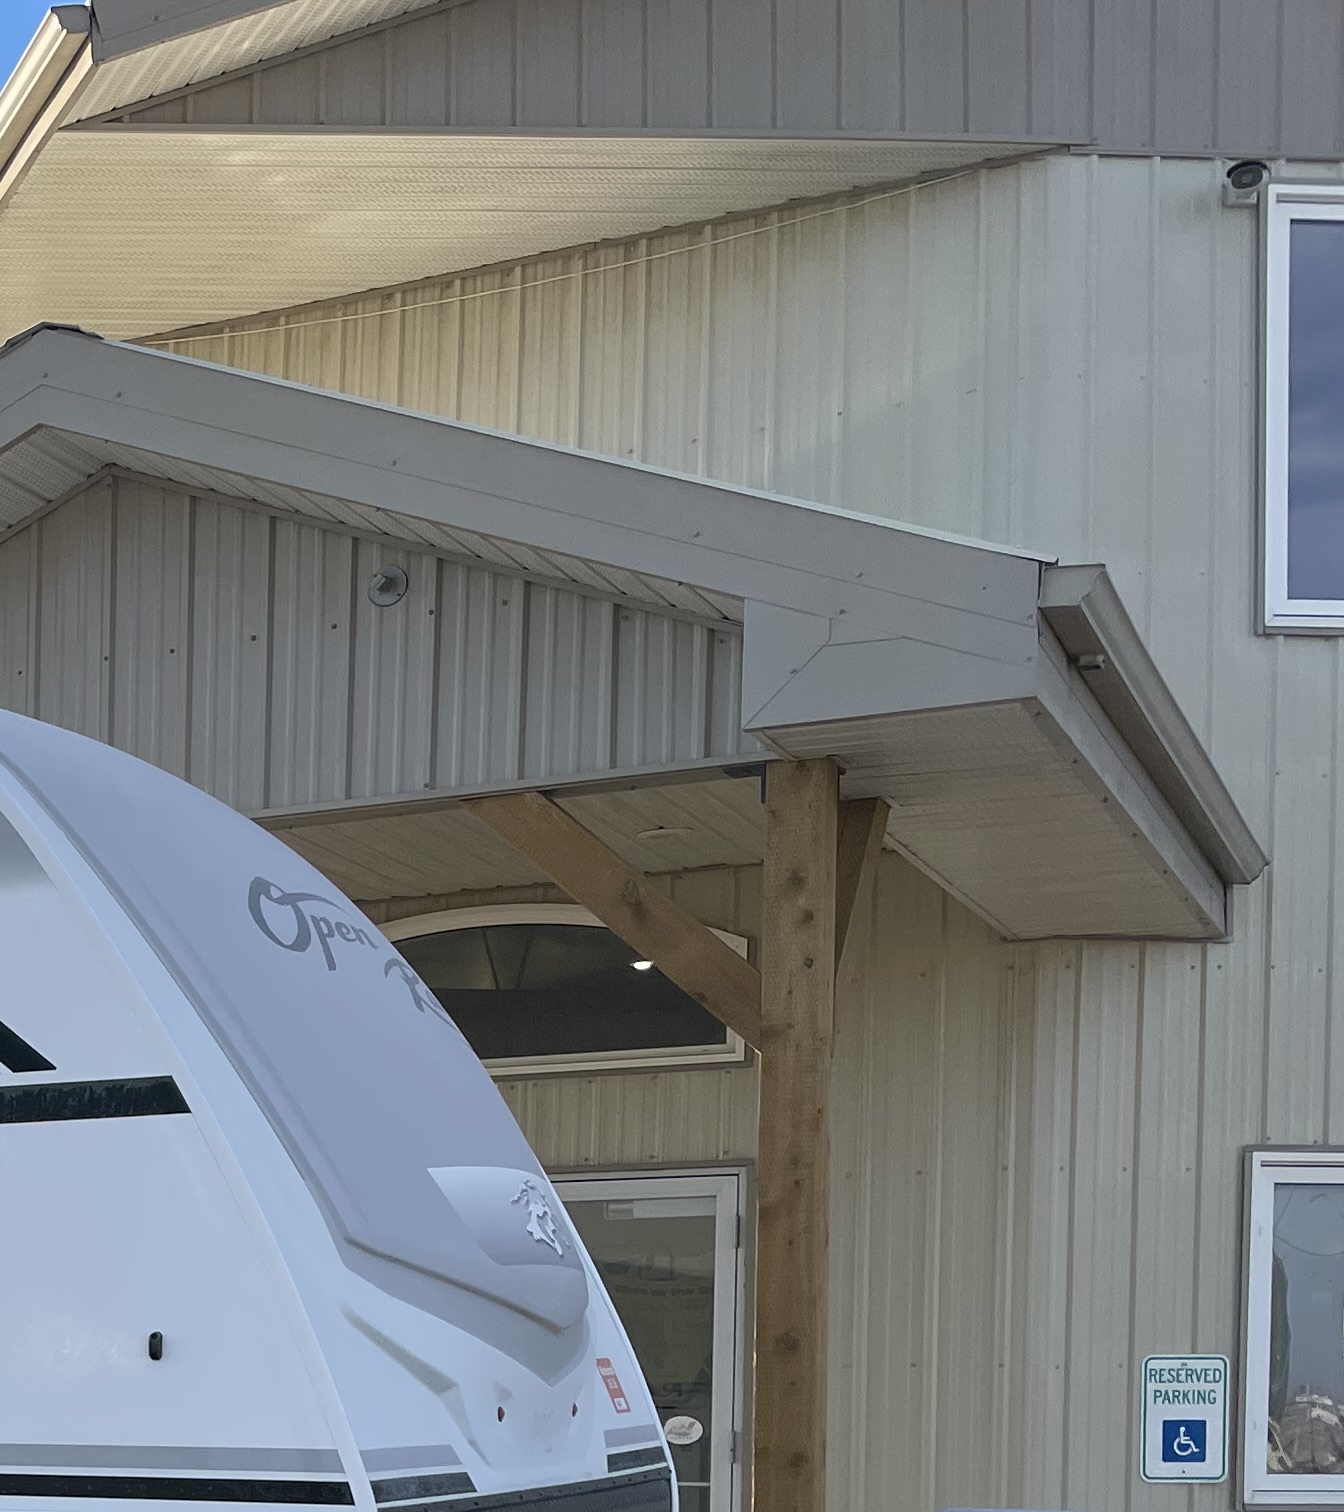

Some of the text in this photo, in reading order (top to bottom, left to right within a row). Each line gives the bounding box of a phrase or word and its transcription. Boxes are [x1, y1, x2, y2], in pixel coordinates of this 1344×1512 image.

[248, 876, 378, 971] Open
[1149, 1367, 1223, 1384] RESERVED
[1153, 1389, 1217, 1405] PARKING
